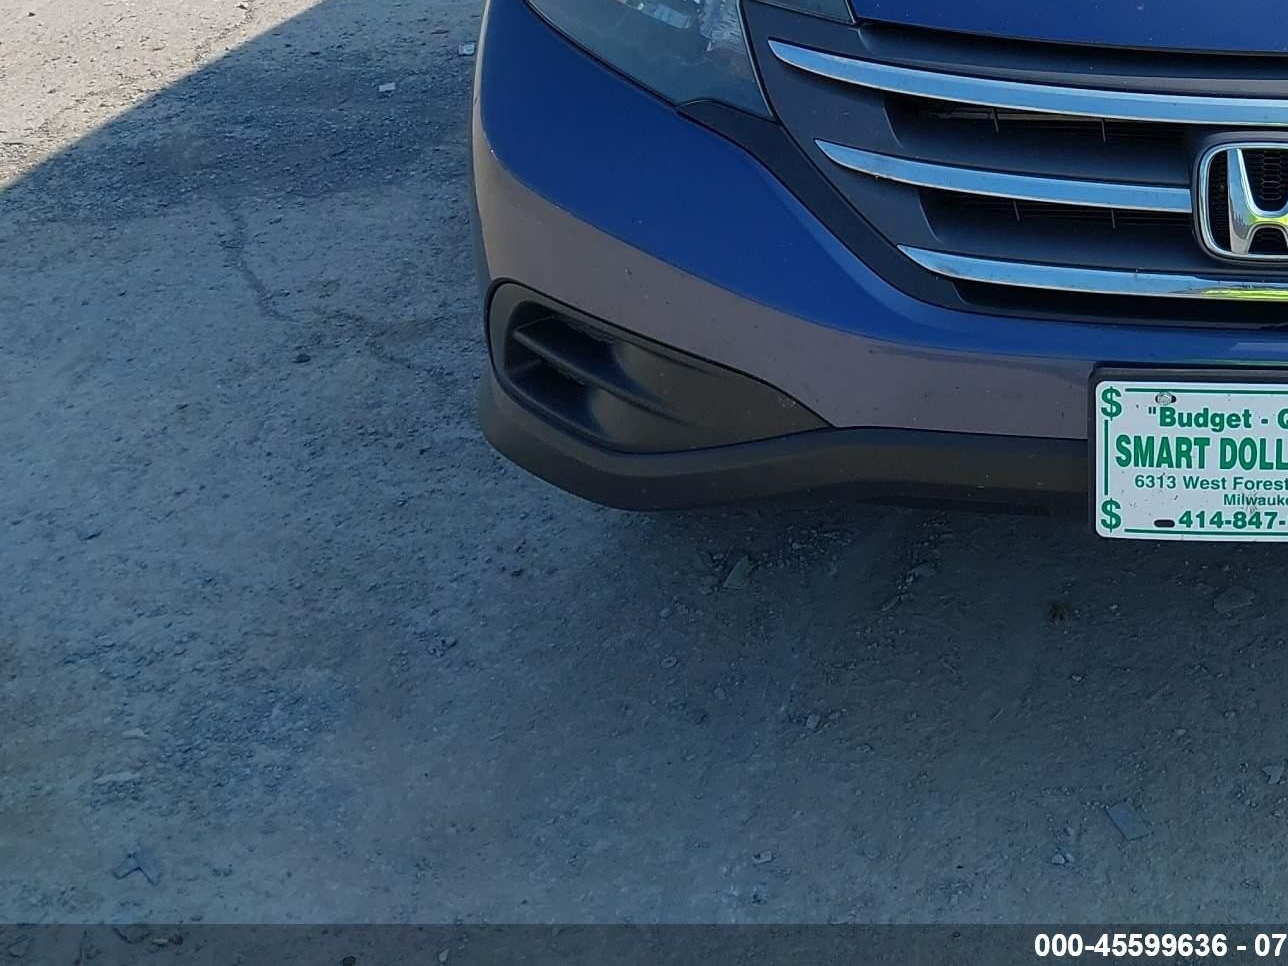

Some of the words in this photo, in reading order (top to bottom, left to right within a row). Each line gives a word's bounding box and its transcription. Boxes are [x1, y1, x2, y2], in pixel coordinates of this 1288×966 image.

[1101, 387, 1122, 421] $
[1115, 434, 1210, 469] SMART
[1134, 474, 1177, 489] 6313
[1183, 475, 1228, 491] West
[1233, 476, 1288, 491] Forest
[1101, 498, 1121, 533] $
